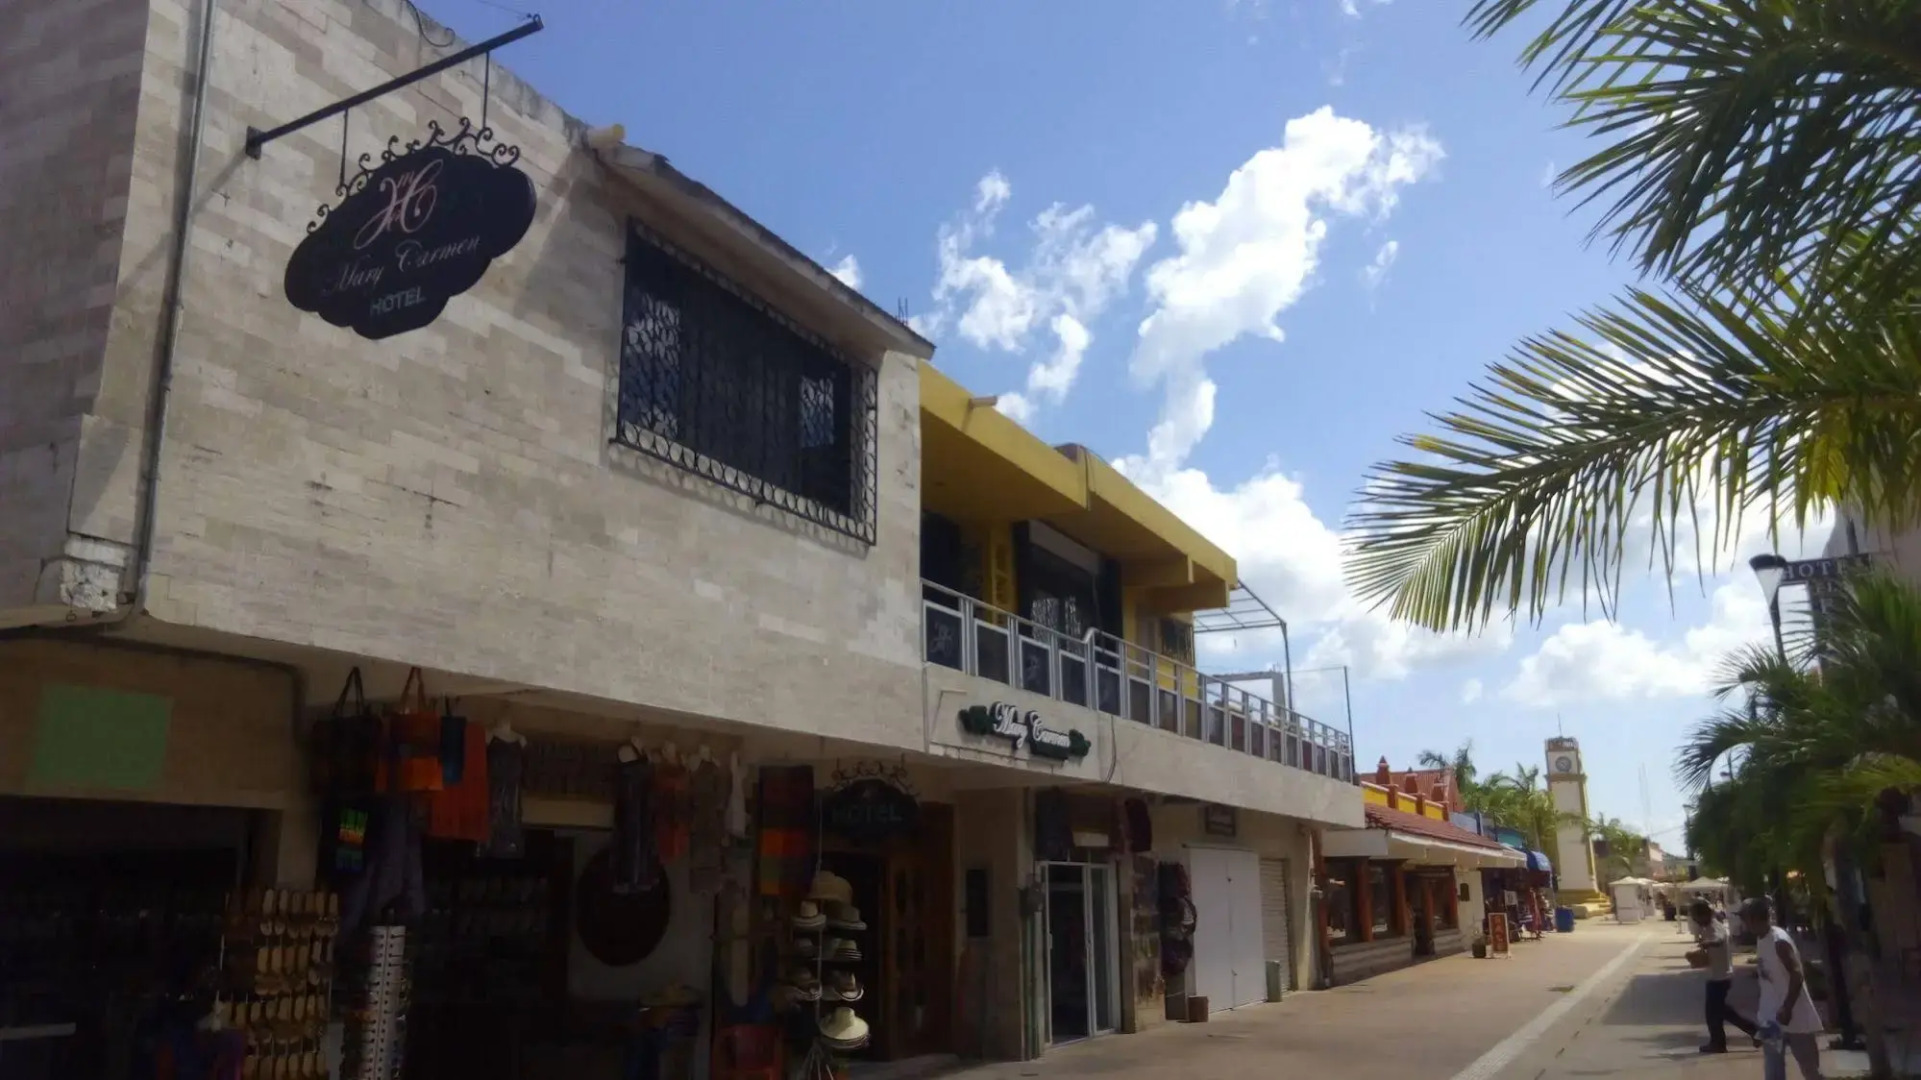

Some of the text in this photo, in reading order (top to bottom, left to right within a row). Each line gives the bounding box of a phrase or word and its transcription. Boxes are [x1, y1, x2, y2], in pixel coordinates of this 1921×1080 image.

[322, 254, 384, 296] Mary
[369, 286, 427, 316] HOTEL
[831, 802, 902, 824] HOTEL
